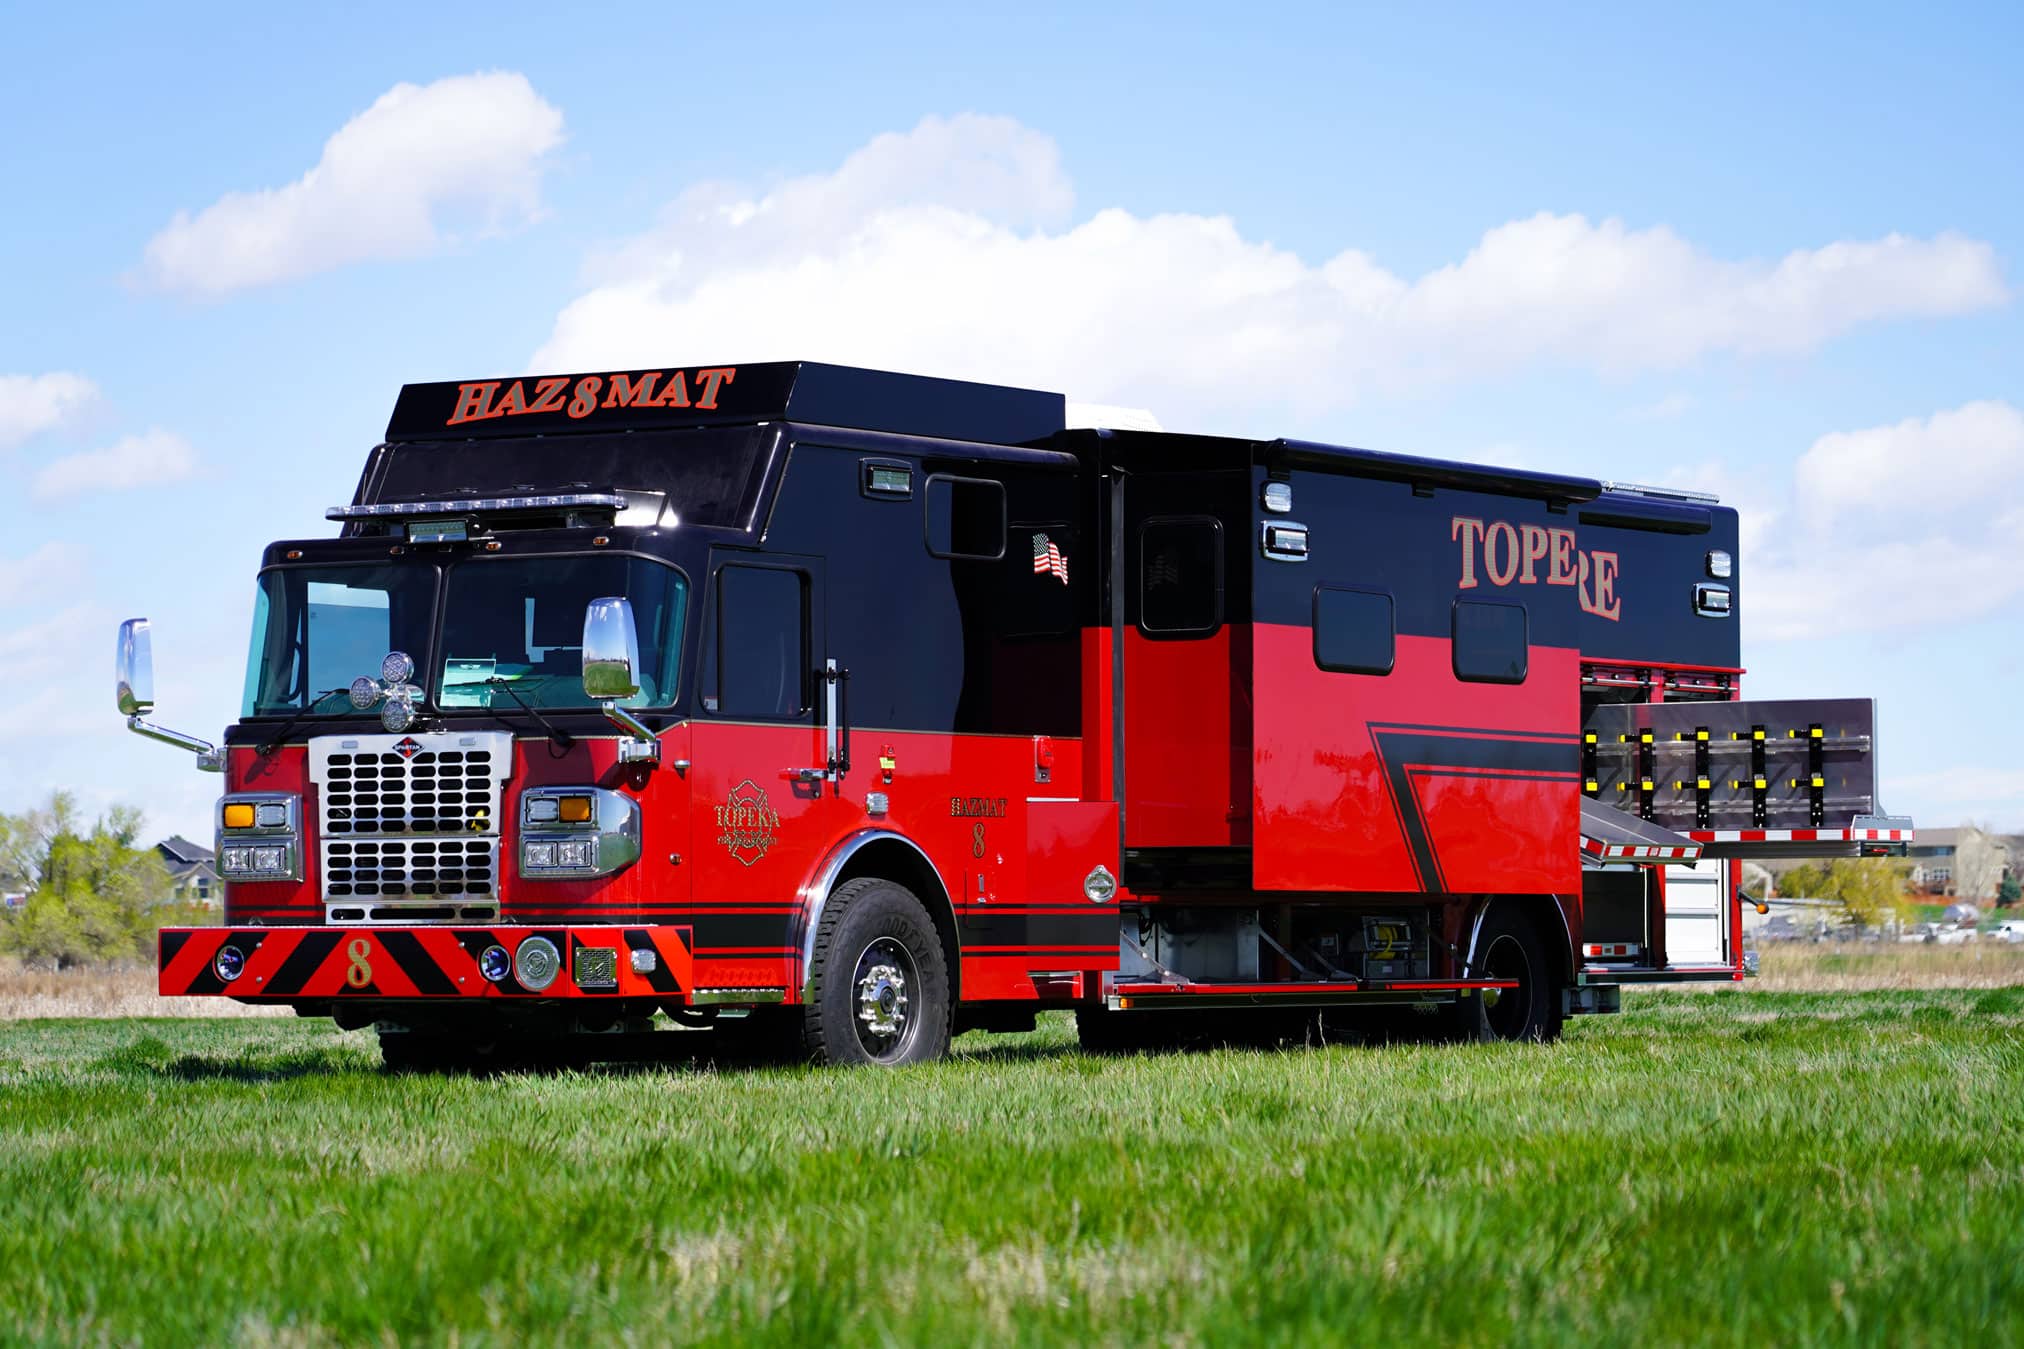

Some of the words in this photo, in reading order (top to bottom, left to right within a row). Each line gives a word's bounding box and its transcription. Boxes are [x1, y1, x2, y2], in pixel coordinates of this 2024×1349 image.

[713, 805, 780, 828] TOPEKA
[951, 797, 1007, 817] HAZMAT
[973, 822, 985, 858] 8
[347, 938, 372, 988] 8
